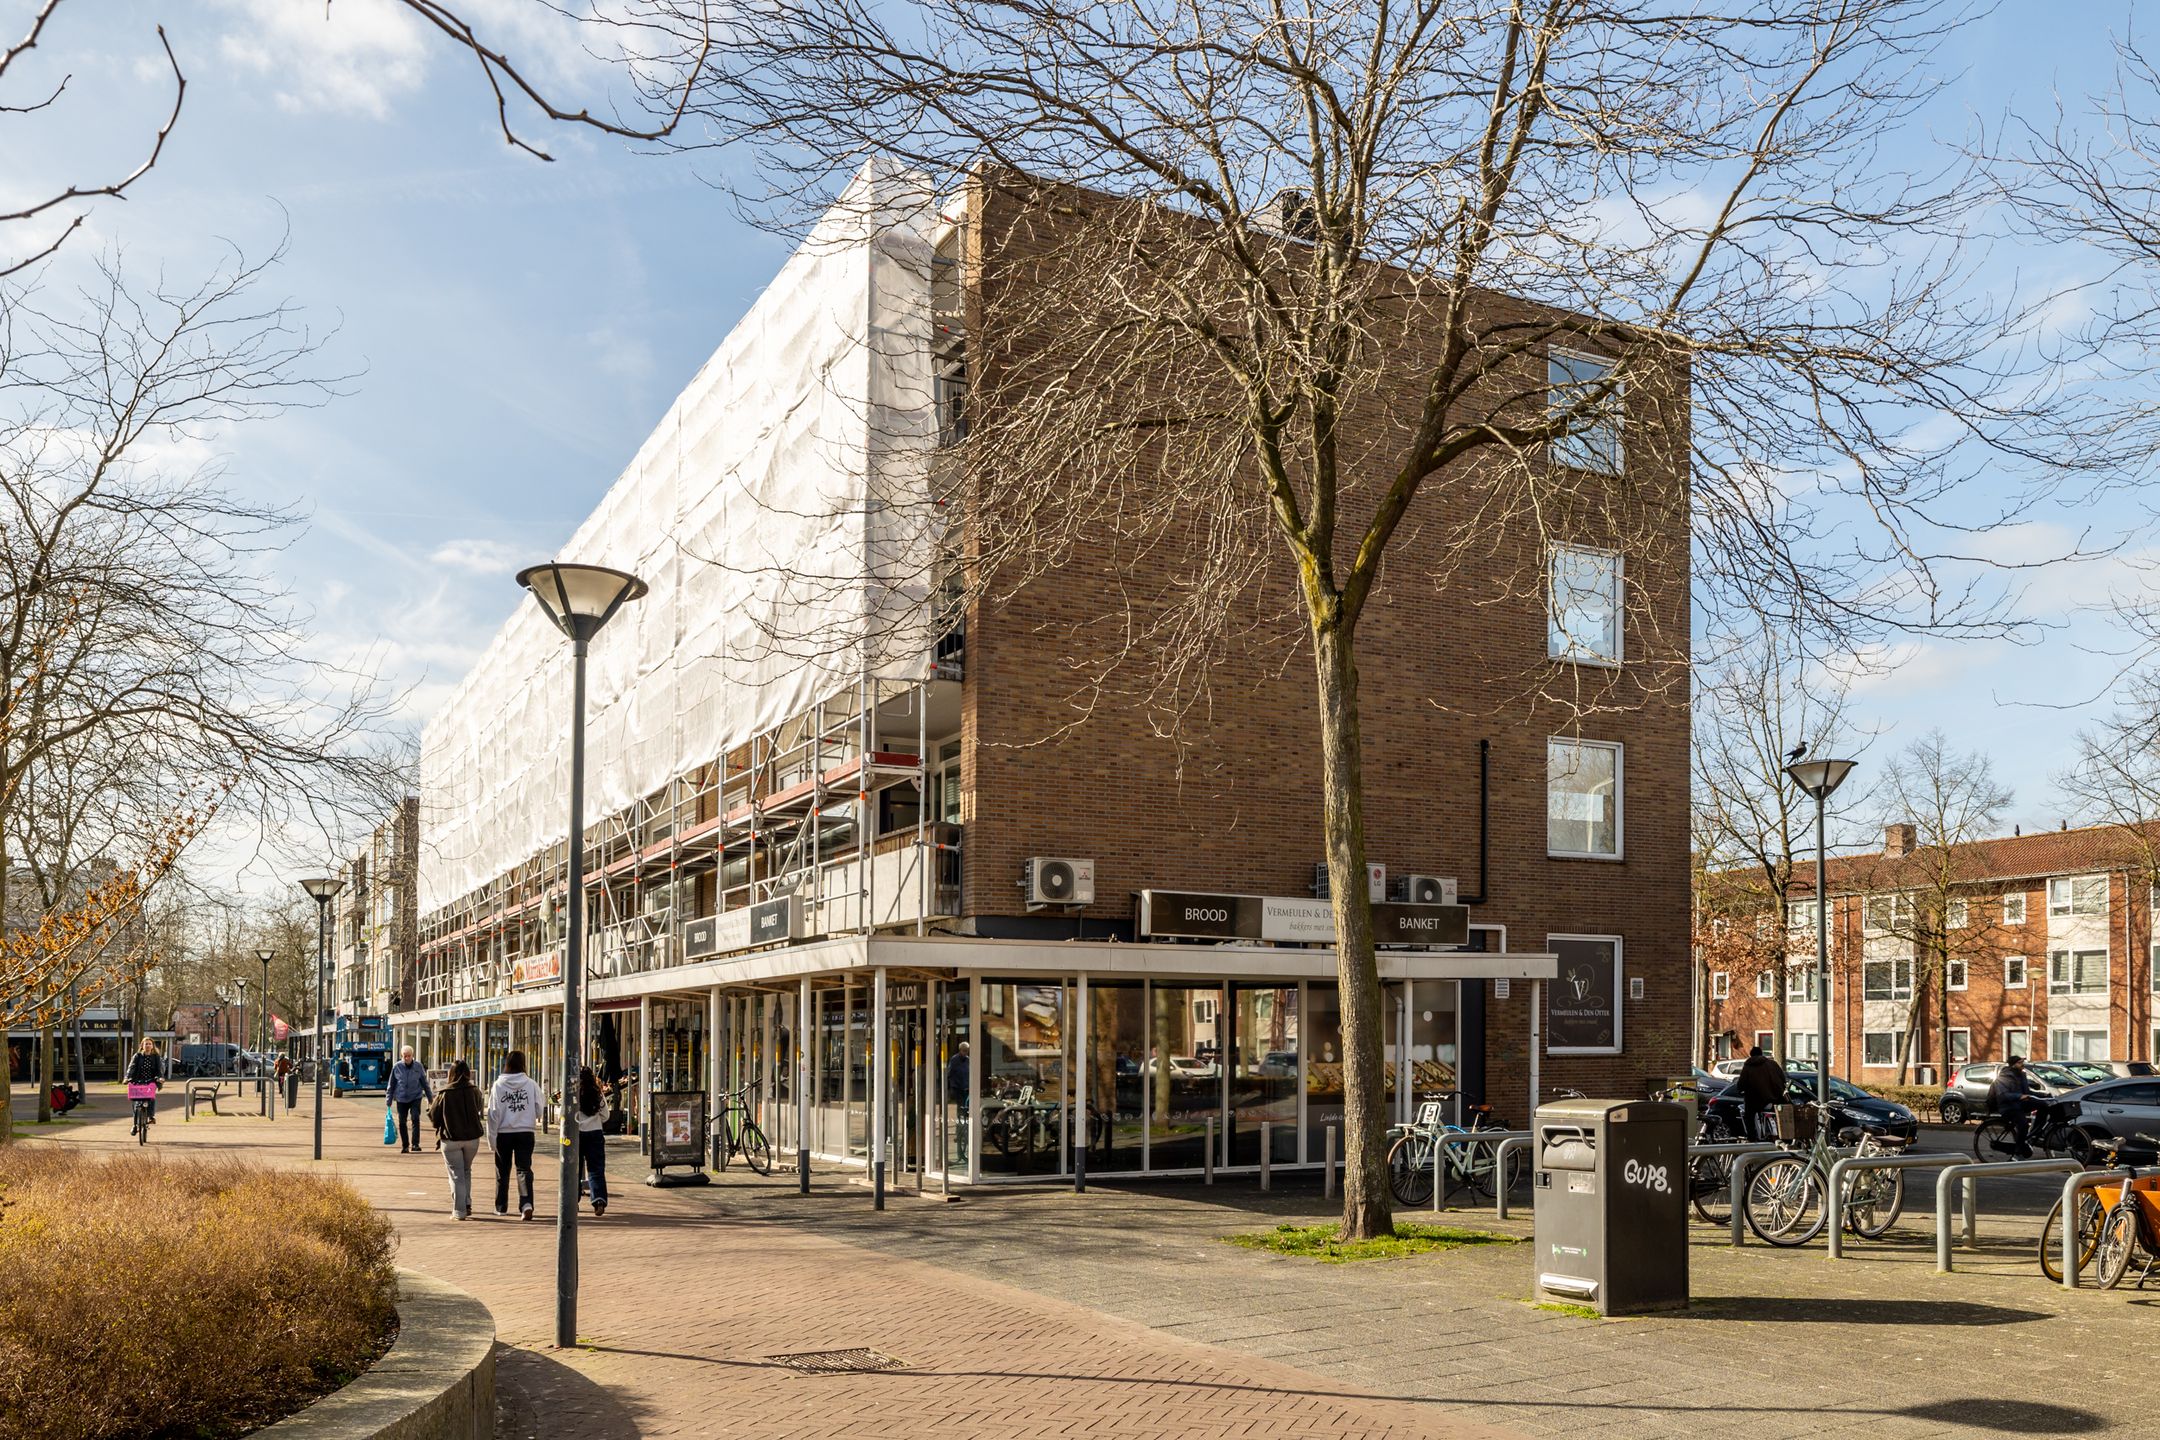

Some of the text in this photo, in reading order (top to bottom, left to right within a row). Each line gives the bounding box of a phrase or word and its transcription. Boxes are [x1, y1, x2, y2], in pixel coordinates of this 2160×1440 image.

[1185, 907, 1228, 922] BROOD
[1267, 906, 1312, 918] VERMEULEN
[1314, 908, 1321, 918] &
[761, 913, 778, 928] BANKET
[1399, 917, 1440, 930] BANKET
